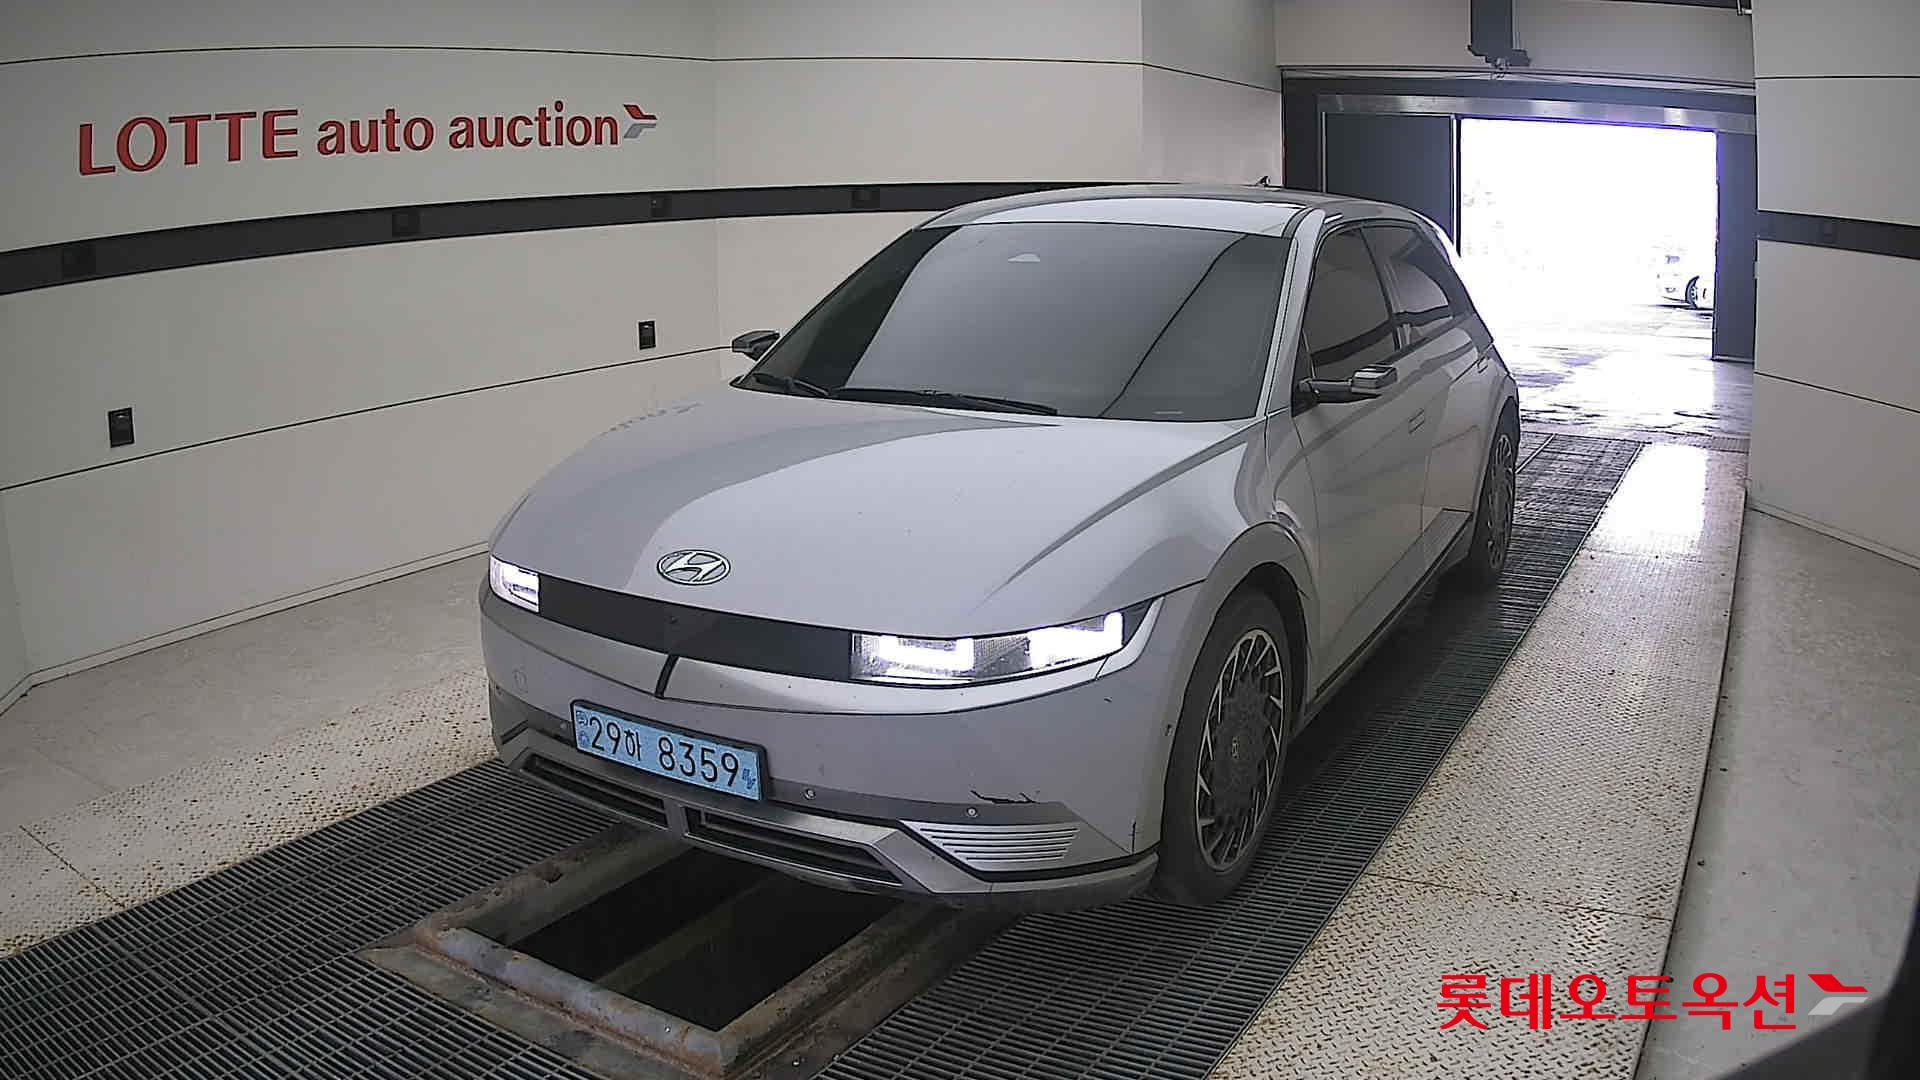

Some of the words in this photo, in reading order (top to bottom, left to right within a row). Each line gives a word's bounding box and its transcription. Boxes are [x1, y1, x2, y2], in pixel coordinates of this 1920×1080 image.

[79, 109, 298, 175] LOTTE
[317, 108, 434, 155] auto
[449, 100, 618, 148] auction
[590, 717, 641, 761] 29하
[658, 736, 739, 786] 8359
